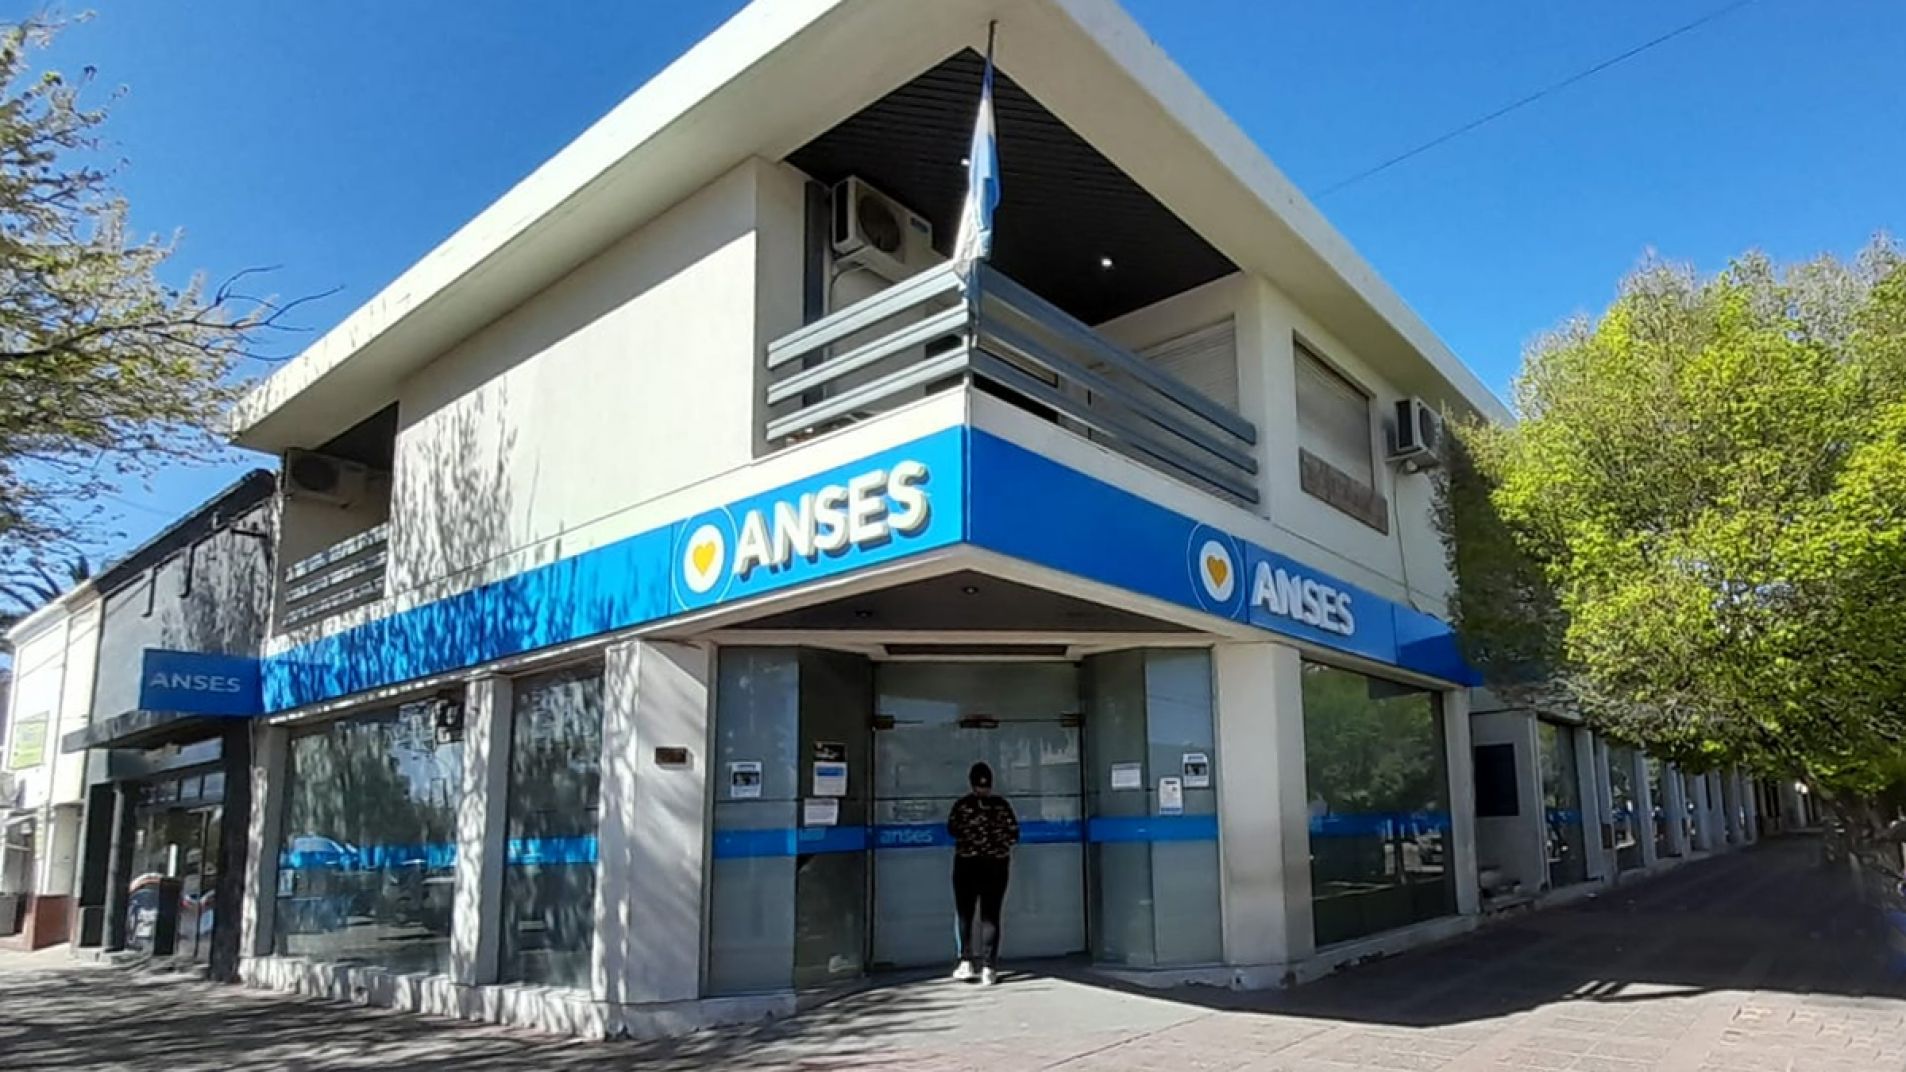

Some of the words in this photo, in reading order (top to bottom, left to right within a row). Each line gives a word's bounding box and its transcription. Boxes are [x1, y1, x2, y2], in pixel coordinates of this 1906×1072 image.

[734, 460, 929, 574] ANSES
[1250, 561, 1354, 635] ANSES
[149, 672, 241, 693] ANSES
